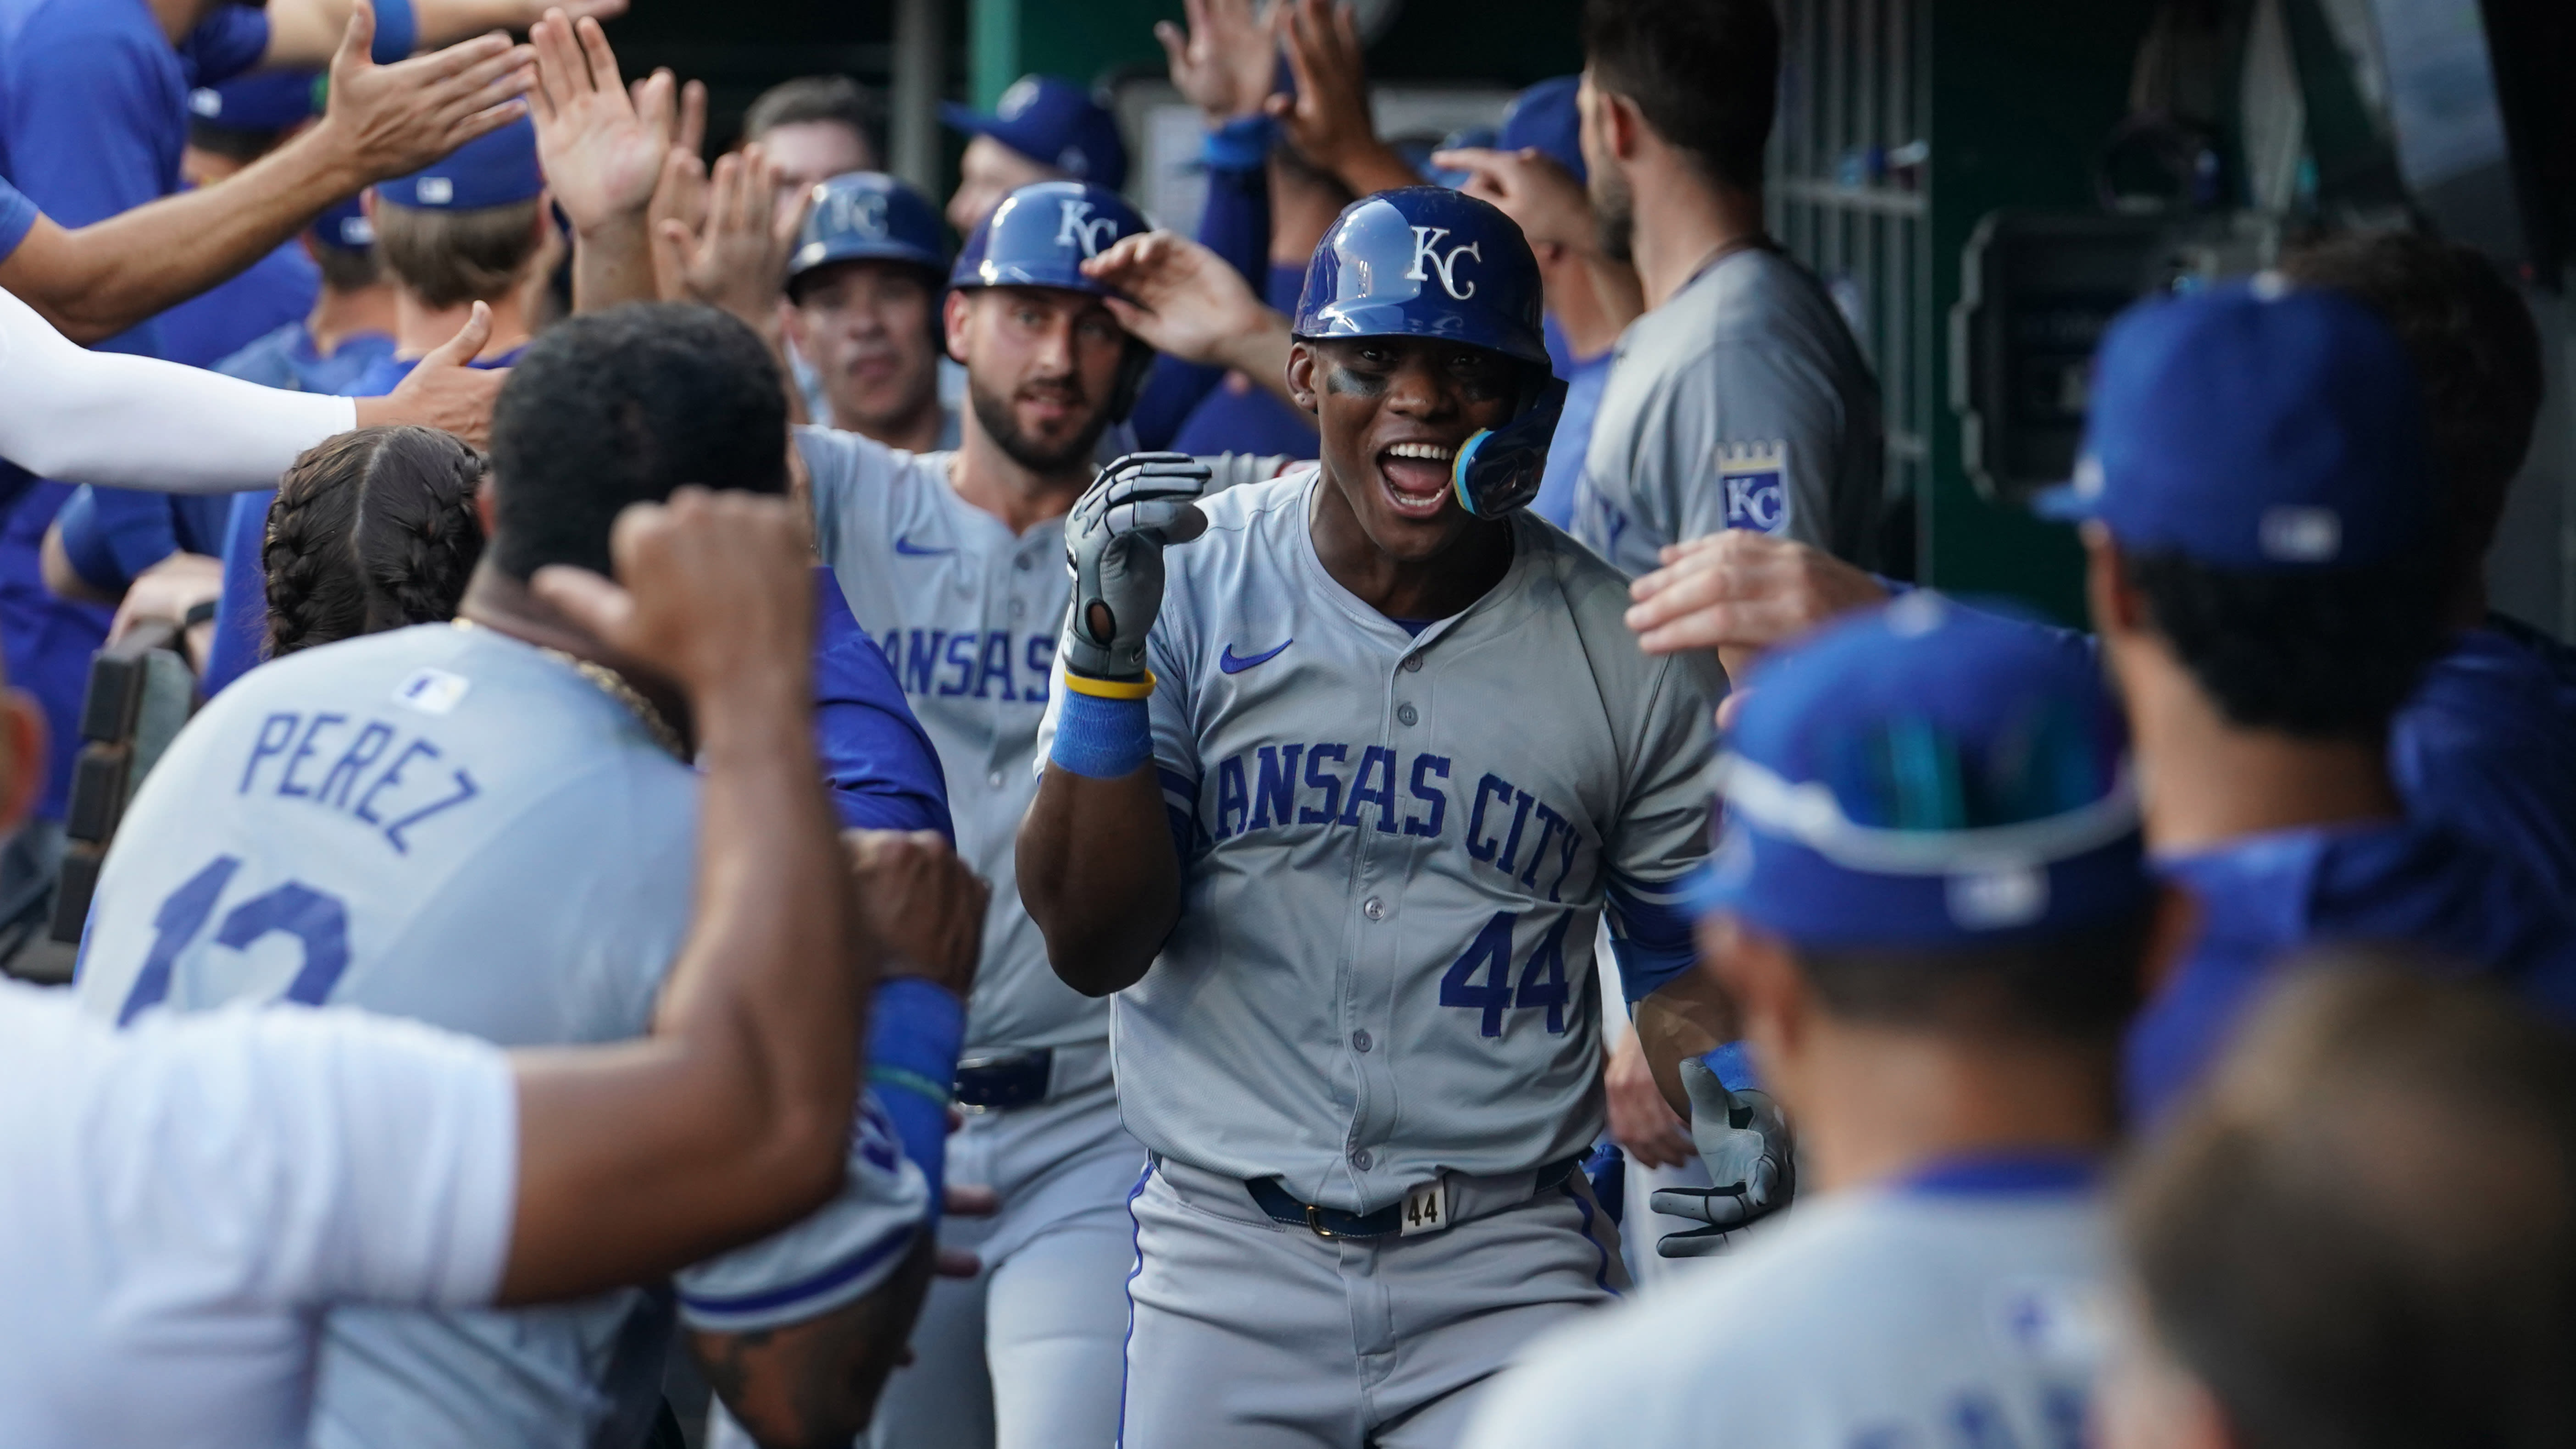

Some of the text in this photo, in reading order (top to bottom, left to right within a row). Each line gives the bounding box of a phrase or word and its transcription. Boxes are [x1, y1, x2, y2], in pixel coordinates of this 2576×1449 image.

[828, 187, 888, 239] KC
[1405, 225, 1482, 300] KC
[1723, 477, 1782, 528] KC
[883, 628, 1055, 702] ANSAS
[239, 712, 479, 855] PEREZ
[1196, 743, 1582, 903] ANSAS CITY
[1439, 907, 1575, 1037] 44
[1408, 1192, 1438, 1227] 44
